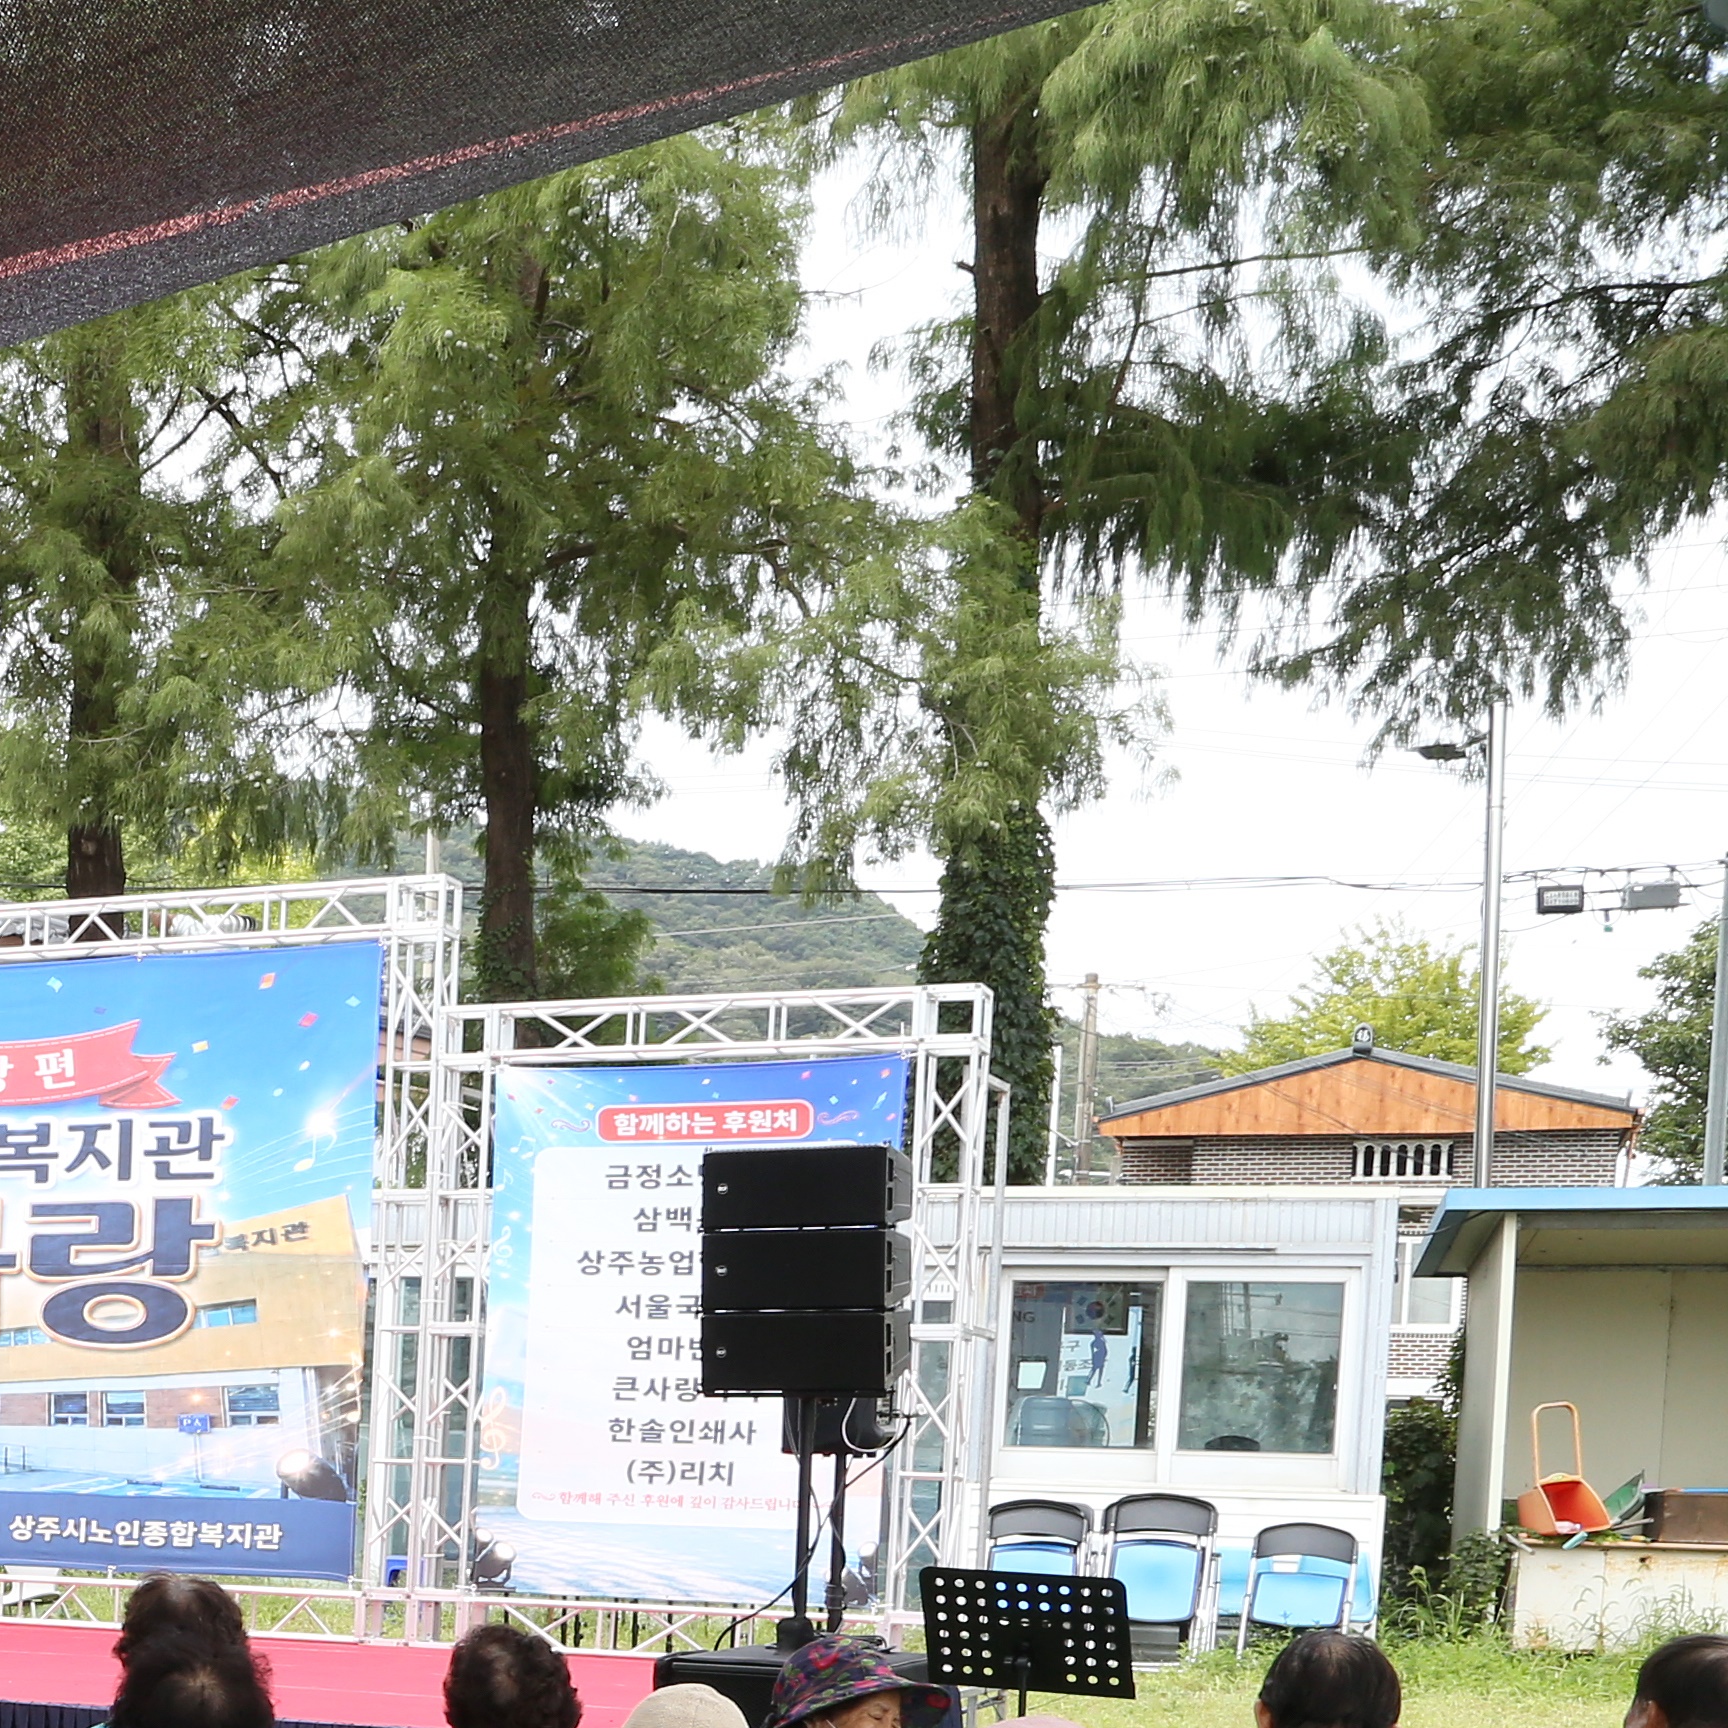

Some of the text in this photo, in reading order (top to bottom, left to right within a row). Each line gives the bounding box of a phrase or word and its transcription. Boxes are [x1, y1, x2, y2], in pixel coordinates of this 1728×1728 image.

[34, 1049, 77, 1089] 편
[613, 1108, 798, 1137] 함께하는 후원처
[604, 1163, 705, 1191] 금정소
[633, 1206, 704, 1233] 삼백
[577, 1250, 704, 1277] 상주농업
[607, 1417, 758, 1446] 한솔인쇄사
[626, 1459, 735, 1487] (주)리치
[558, 1491, 602, 1507] 함께해
[605, 1492, 636, 1508] 주신
[688, 1494, 718, 1510] 깊이
[8, 1515, 284, 1552] 상주시노인종합복지관
